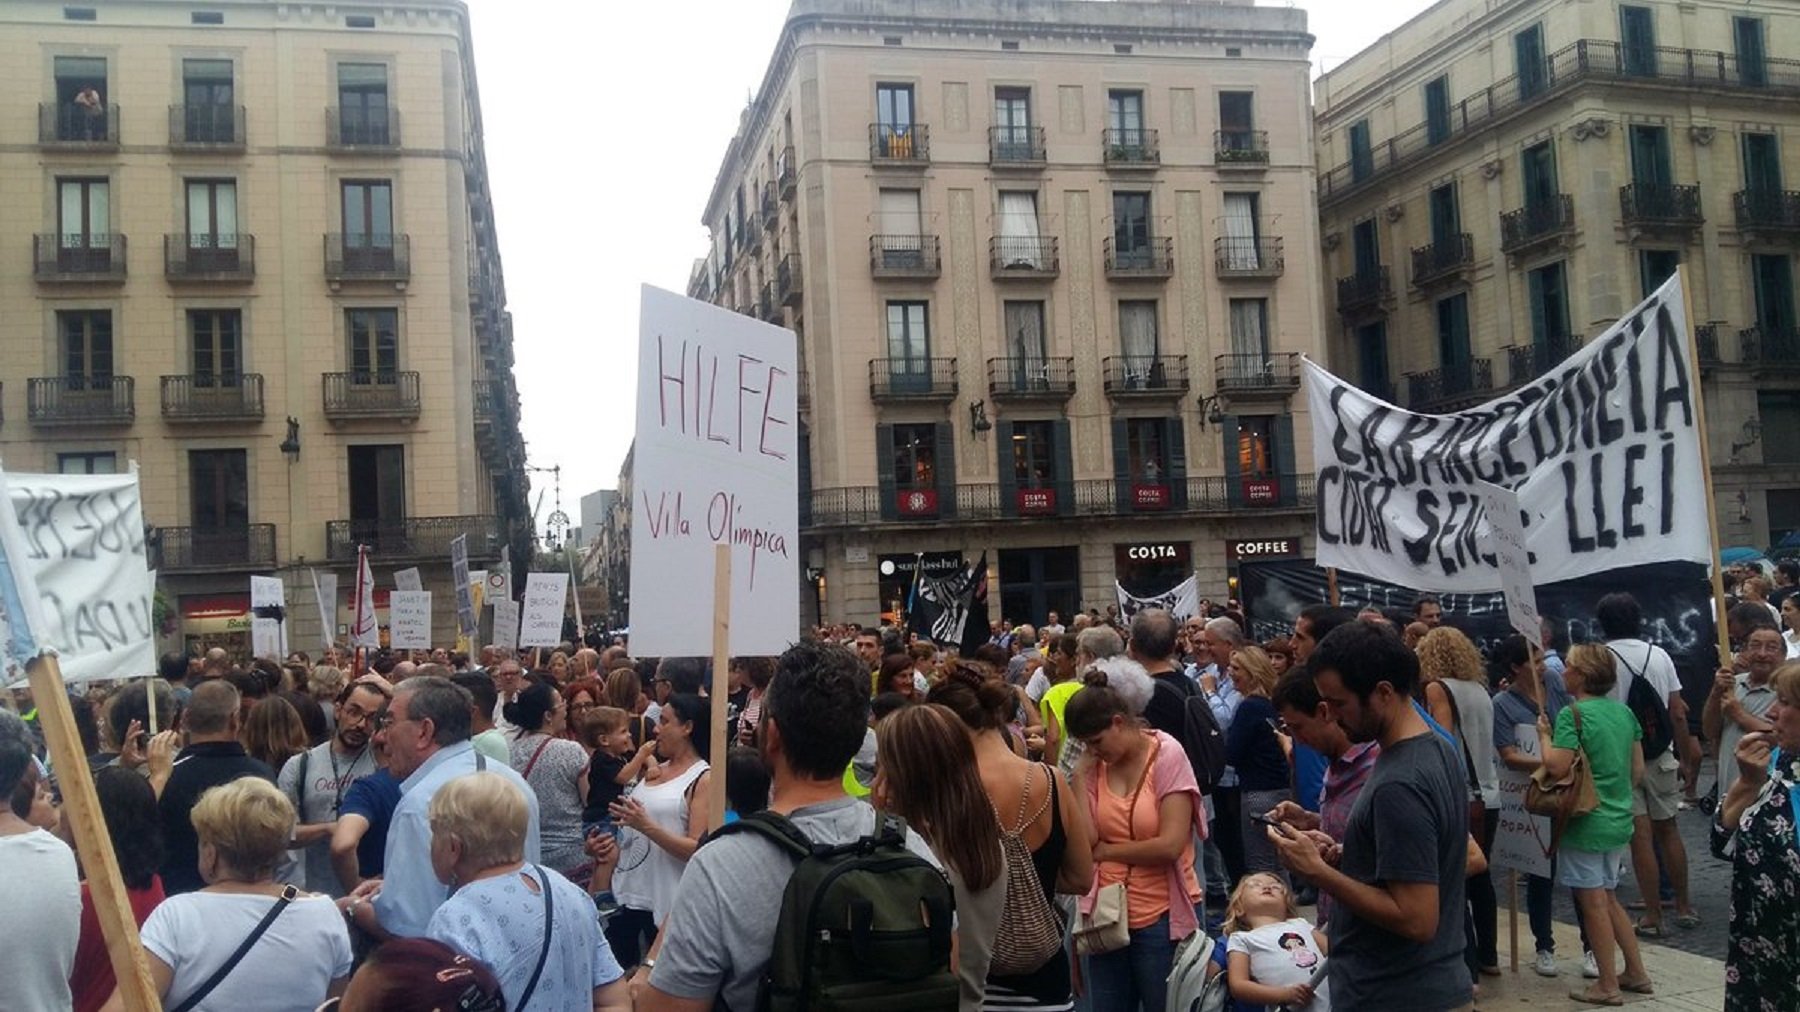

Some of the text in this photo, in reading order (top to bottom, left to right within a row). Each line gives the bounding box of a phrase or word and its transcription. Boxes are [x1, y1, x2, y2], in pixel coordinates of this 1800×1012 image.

[658, 335, 789, 462] HILFE
[1138, 489, 1161, 497] COSTA
[642, 489, 692, 539] Vila
[1128, 541, 1289, 560] COSTA COFFEE
